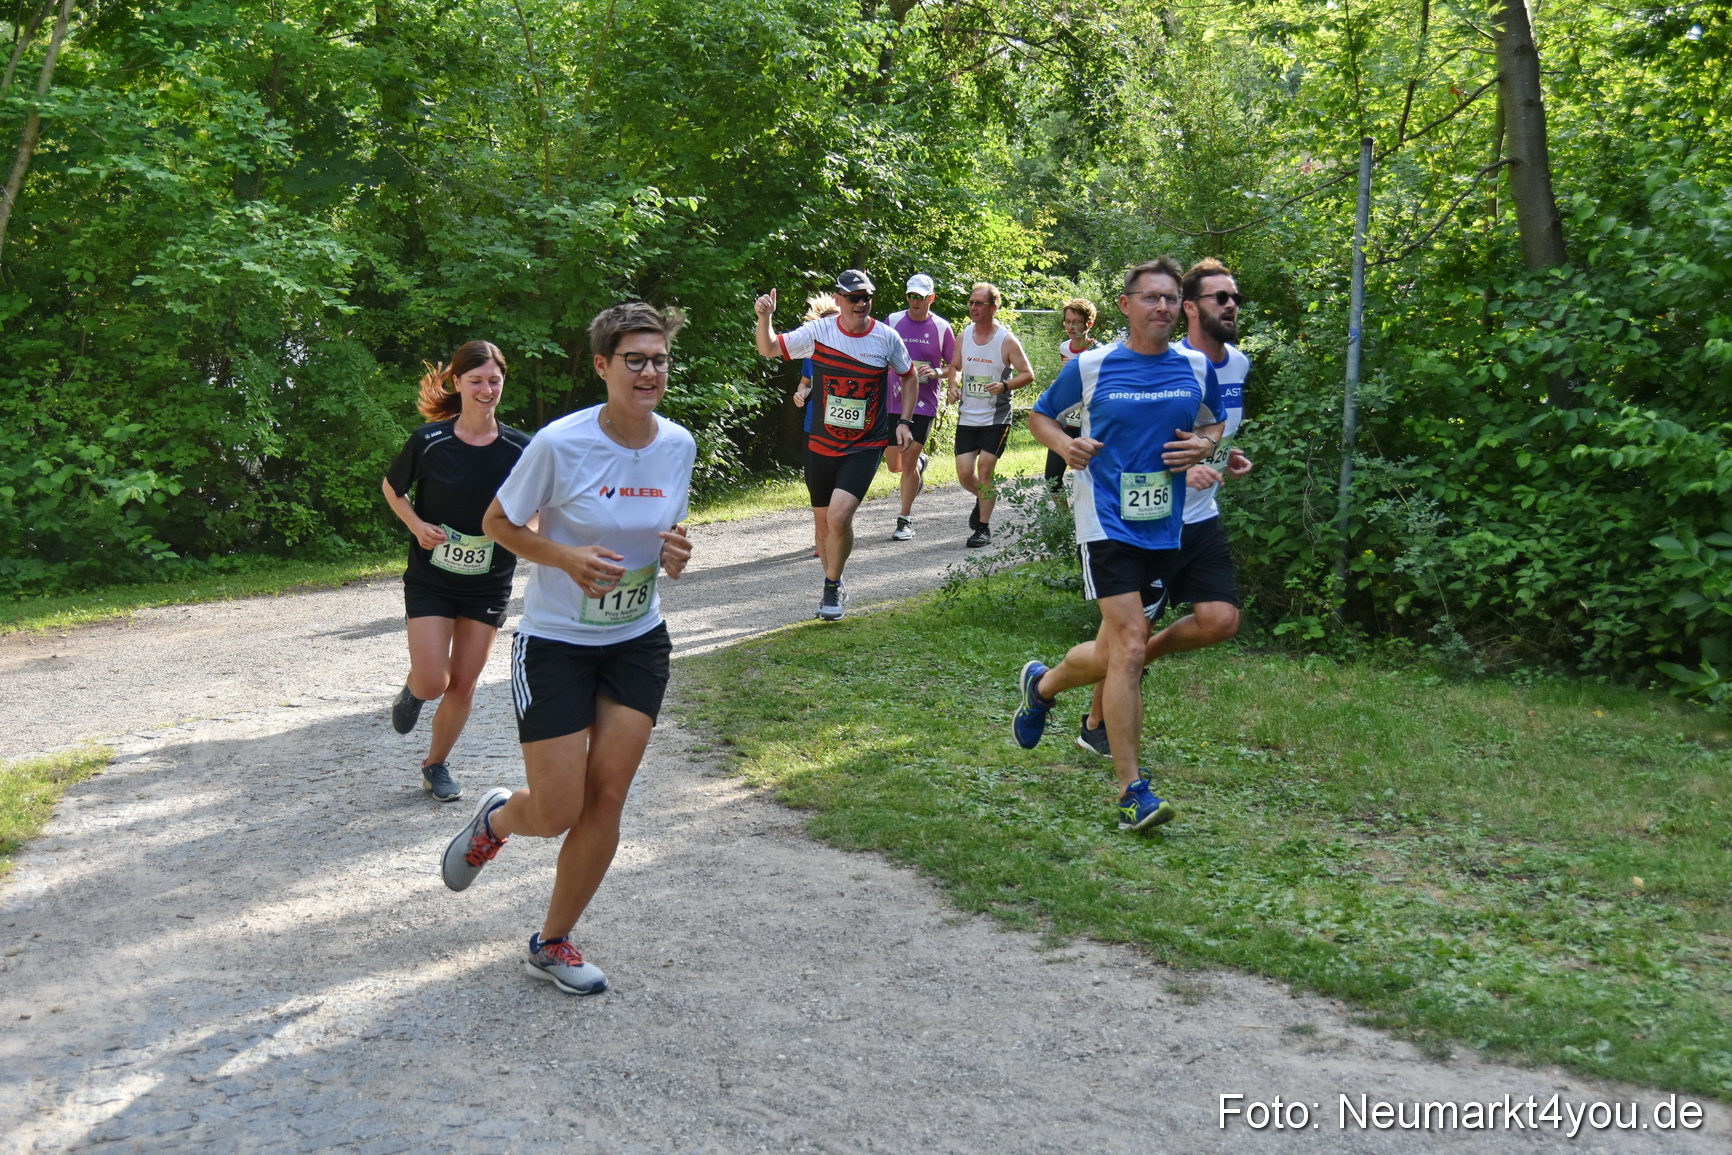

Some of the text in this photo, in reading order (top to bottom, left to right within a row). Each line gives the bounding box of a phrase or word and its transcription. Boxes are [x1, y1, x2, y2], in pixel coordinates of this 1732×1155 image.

[1109, 389, 1191, 400] energiegeladen
[830, 406, 860, 421] 2269
[1197, 447, 1228, 465] 426
[619, 487, 667, 498] KLEBL
[1128, 486, 1169, 507] 2156
[443, 543, 486, 564] 1983
[599, 584, 648, 610] 1178
